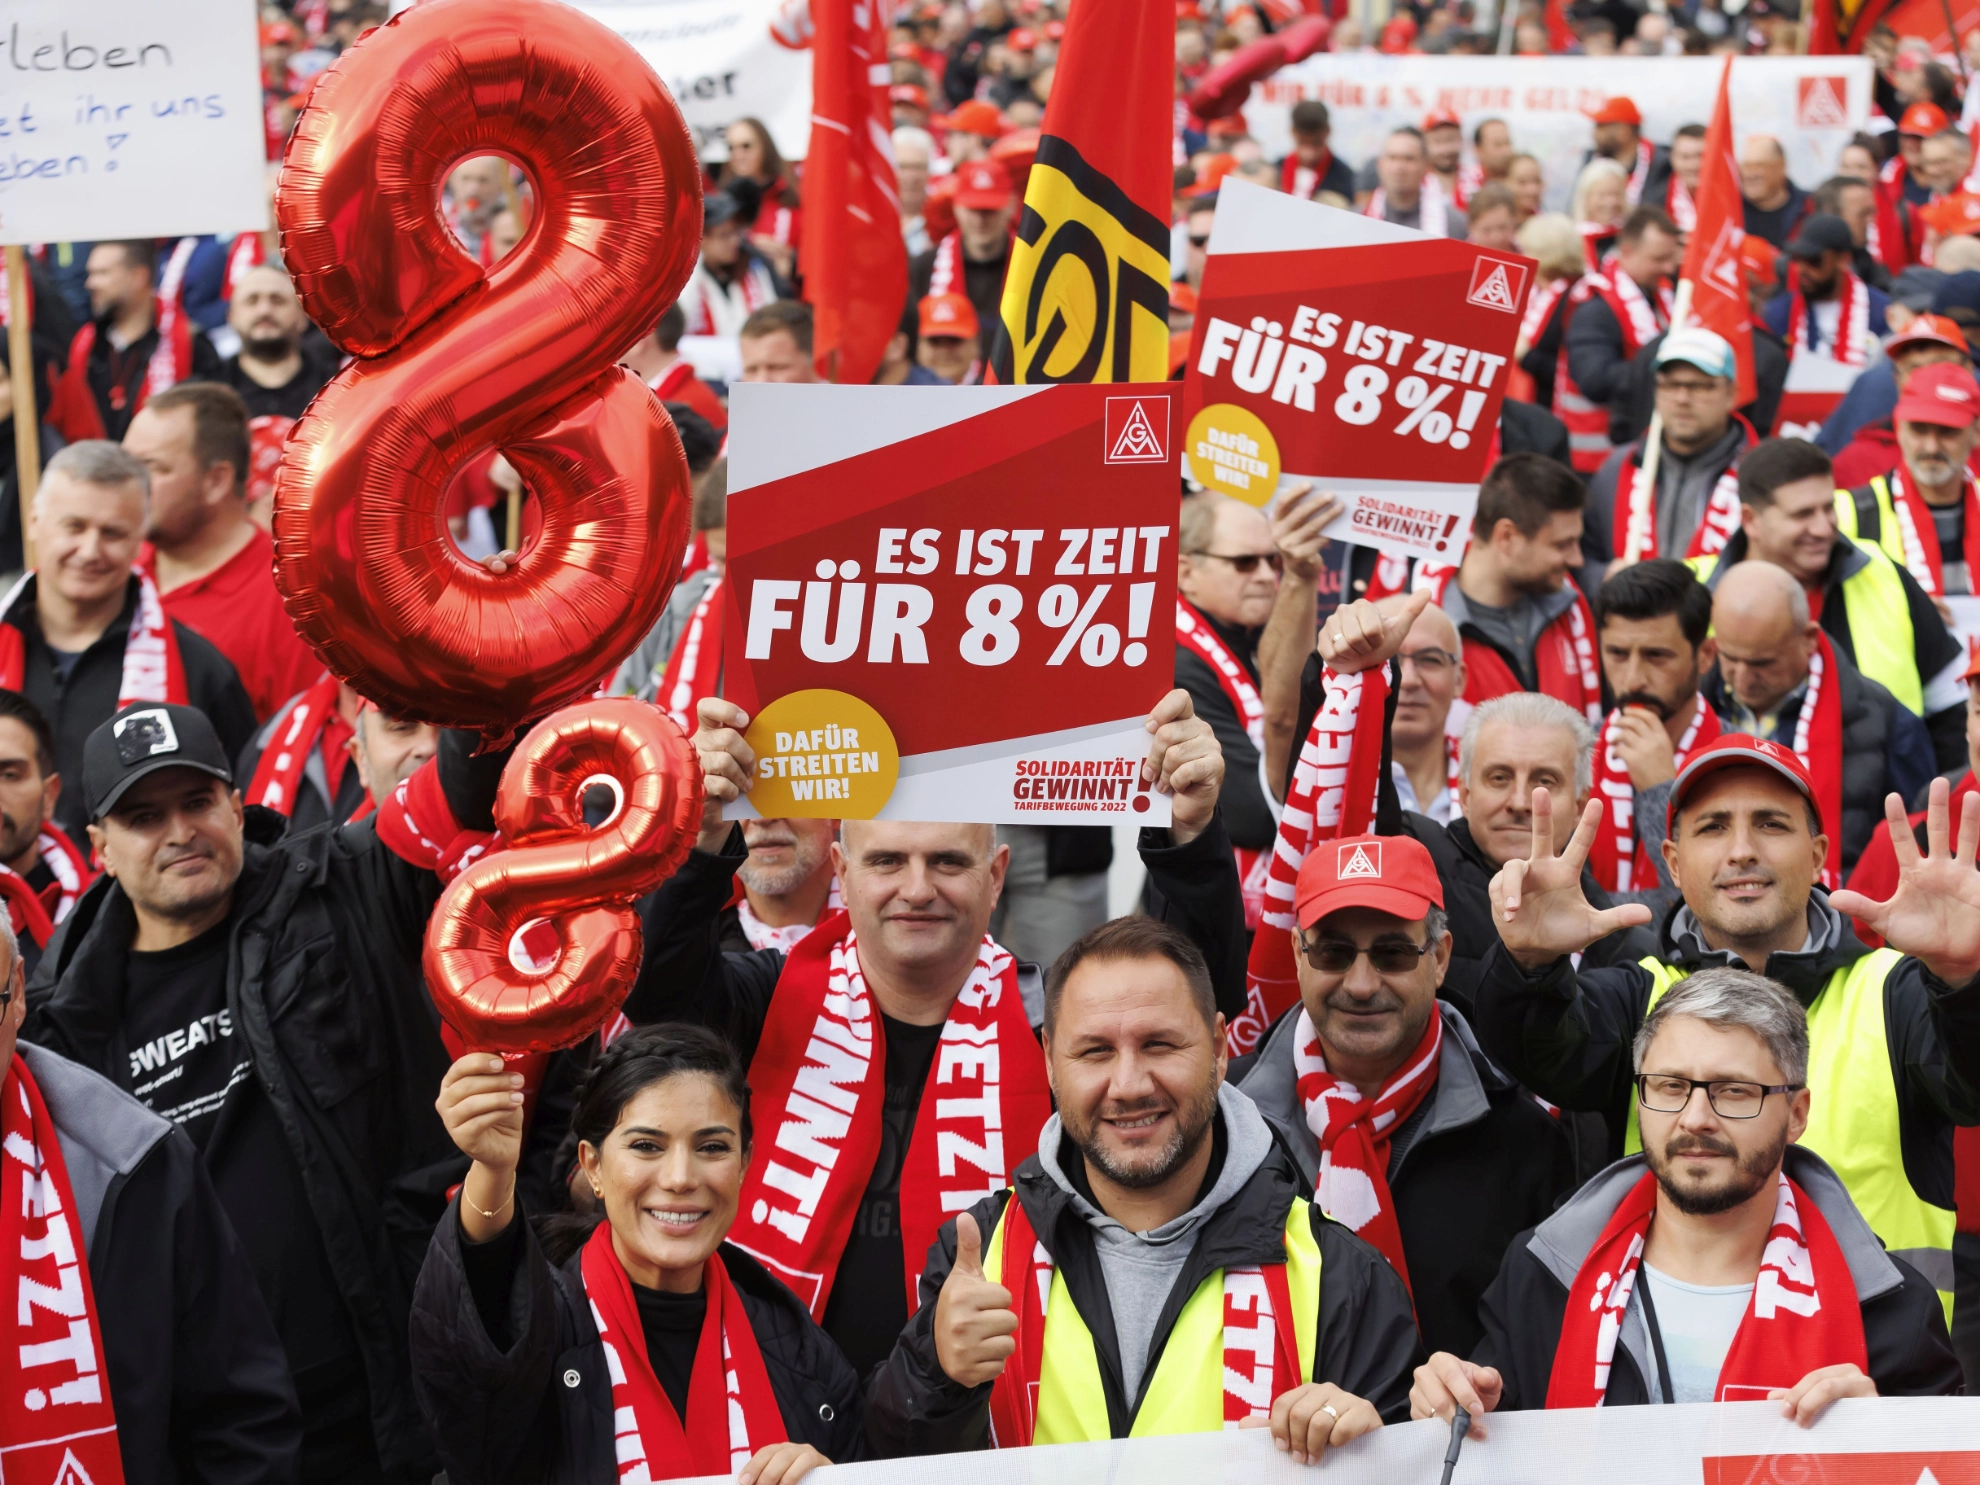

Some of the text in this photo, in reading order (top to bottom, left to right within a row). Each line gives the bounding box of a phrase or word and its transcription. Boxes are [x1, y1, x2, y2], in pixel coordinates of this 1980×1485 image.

[0, 22, 173, 71] leben
[75, 94, 132, 124] ihr
[152, 94, 225, 118] uns
[1289, 304, 1507, 388] ES IST ZEIT
[1197, 316, 1327, 413] FÜR
[1208, 427, 1259, 458] DAFÜR
[1196, 441, 1269, 479] STREITEN
[1213, 463, 1250, 490] WIR!
[1357, 495, 1443, 524] SOLIDARITÄT
[875, 526, 1170, 576] ES IST ZEIT
[745, 559, 934, 664] FÜR
[775, 724, 859, 753] DAFÜR
[759, 752, 879, 780] STREITEN
[1015, 757, 1136, 776] SOLIDARITÄT
[790, 777, 850, 801] WIR!
[1014, 802, 1127, 812] TARIFBEWEGUNG 2022
